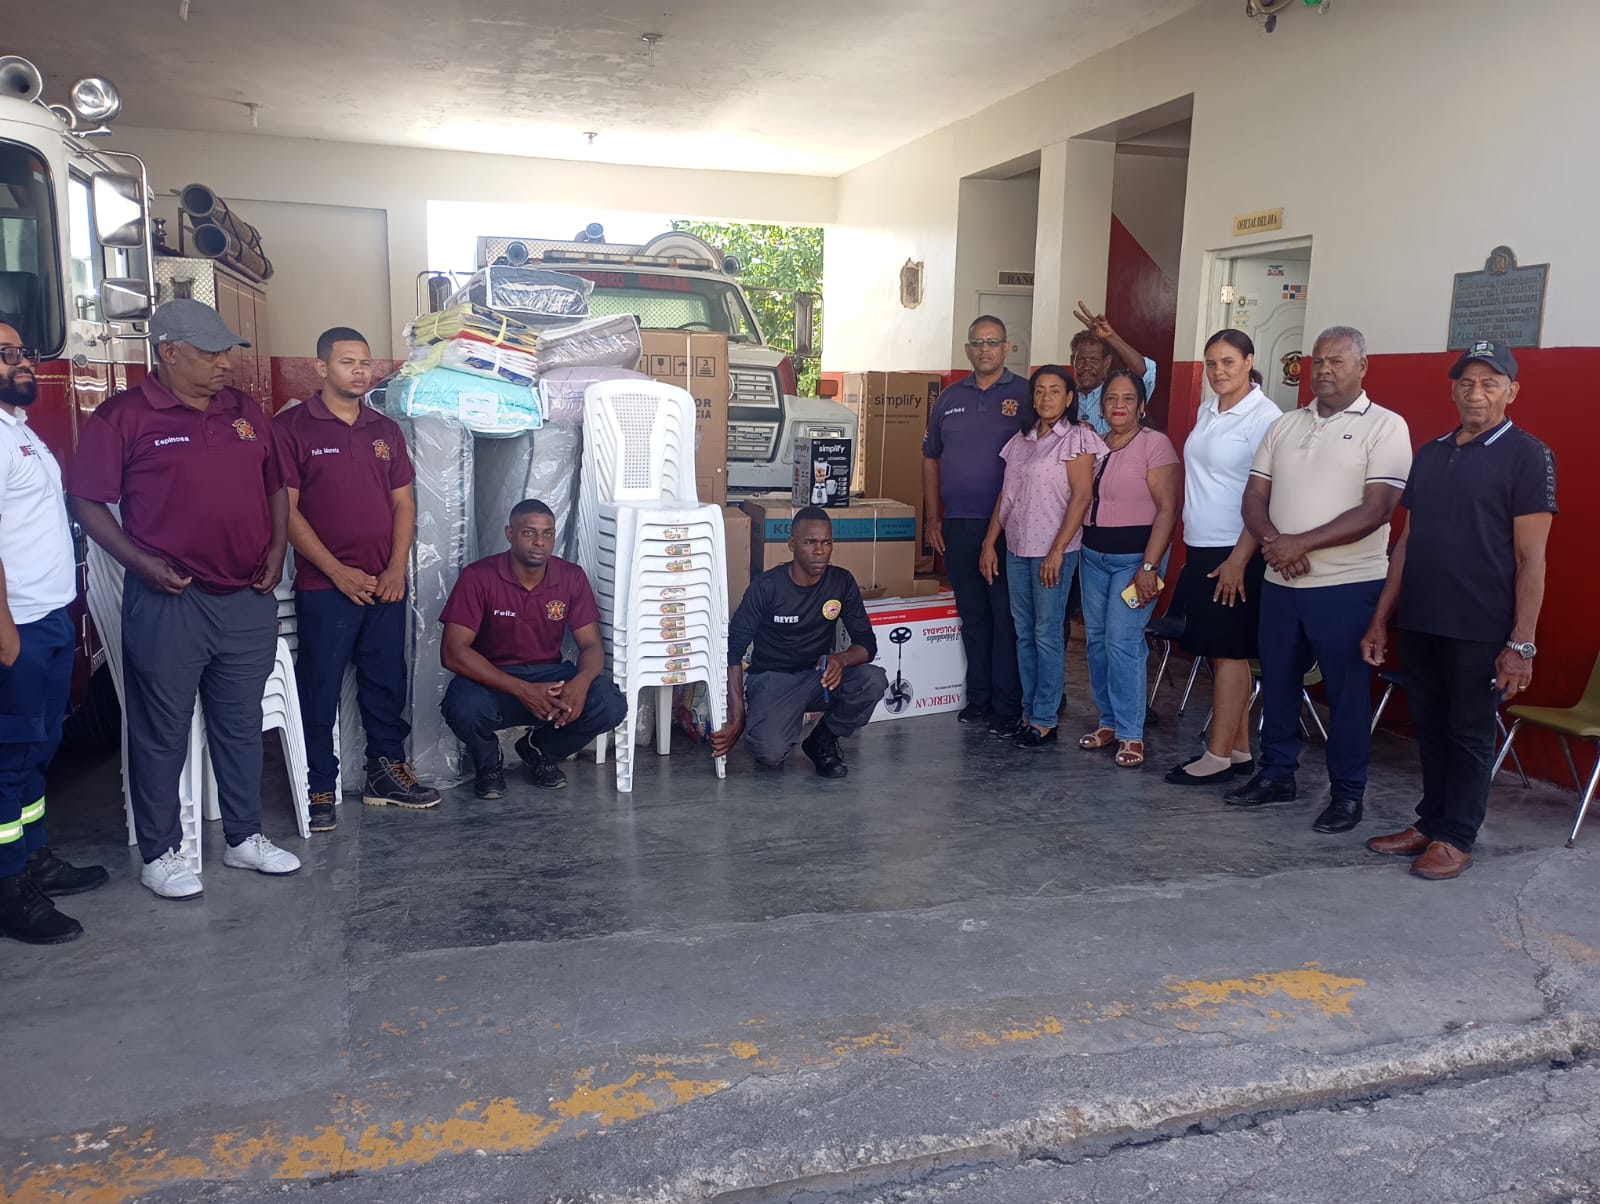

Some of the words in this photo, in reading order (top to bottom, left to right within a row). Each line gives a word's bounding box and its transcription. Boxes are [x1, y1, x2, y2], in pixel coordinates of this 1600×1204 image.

[703, 359, 709, 367] 3
[874, 393, 922, 409] simplify
[154, 436, 190, 447] Espinosa
[818, 444, 846, 454] simplify
[493, 609, 516, 617] Feliz
[773, 615, 799, 623] REYES
[922, 626, 957, 636] PULGADAS
[915, 693, 960, 709] AMERICAN
